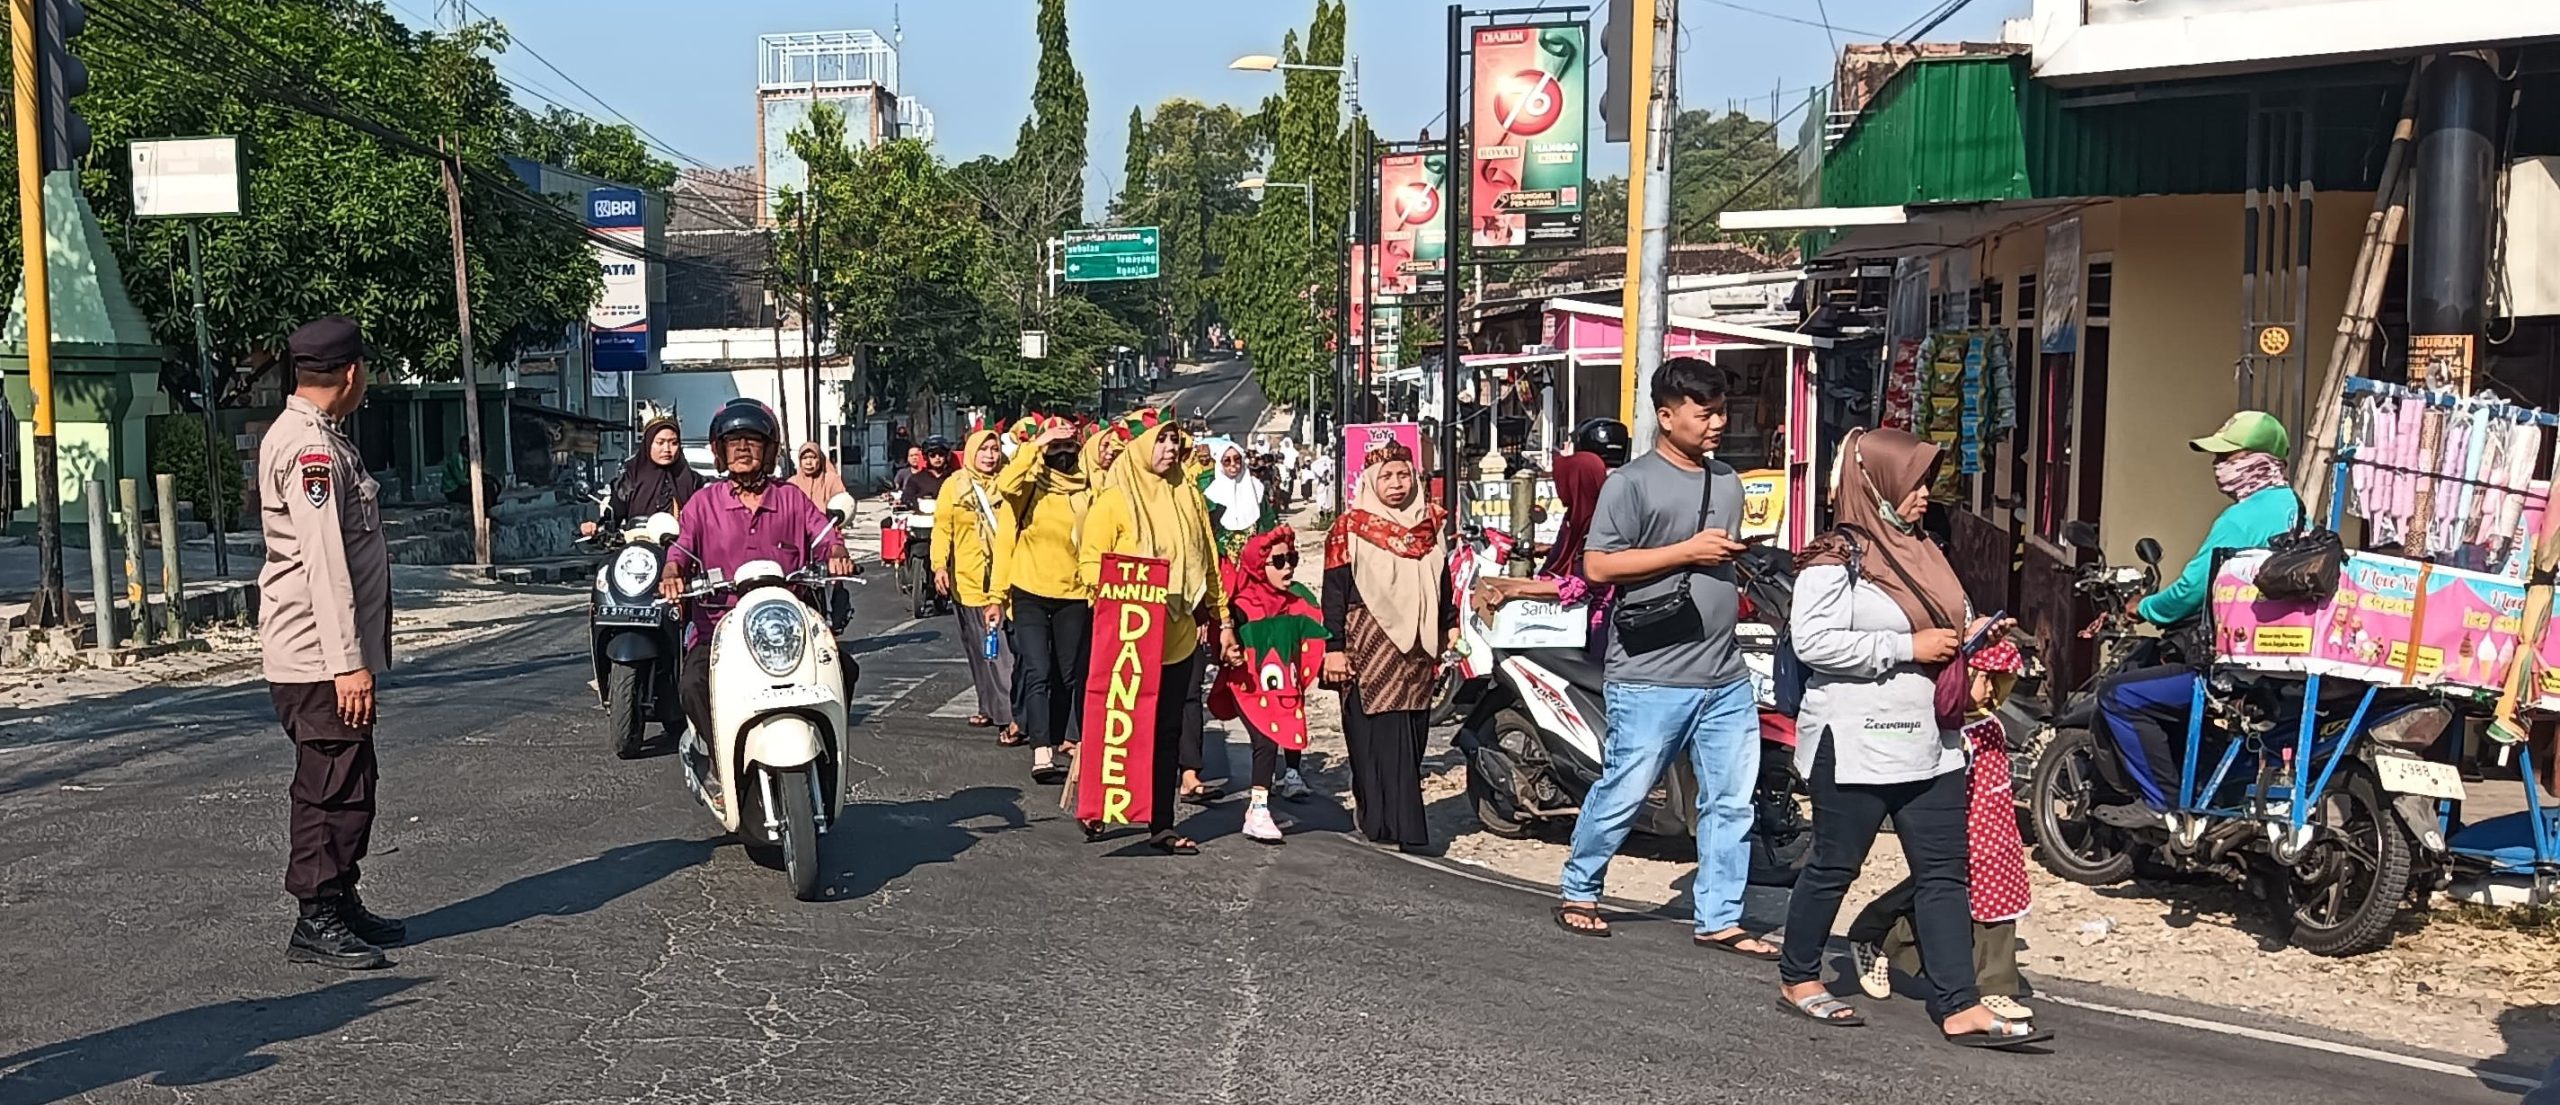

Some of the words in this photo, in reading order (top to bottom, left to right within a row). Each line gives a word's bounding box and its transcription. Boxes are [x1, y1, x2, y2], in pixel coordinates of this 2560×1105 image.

[1480, 148, 1516, 157] ROYAL
[611, 201, 636, 215] BRI
[603, 264, 635, 276] ATM
[1117, 562, 1150, 582] TK
[1520, 601, 1563, 616] Santr
[1101, 603, 1151, 825] DANDER
